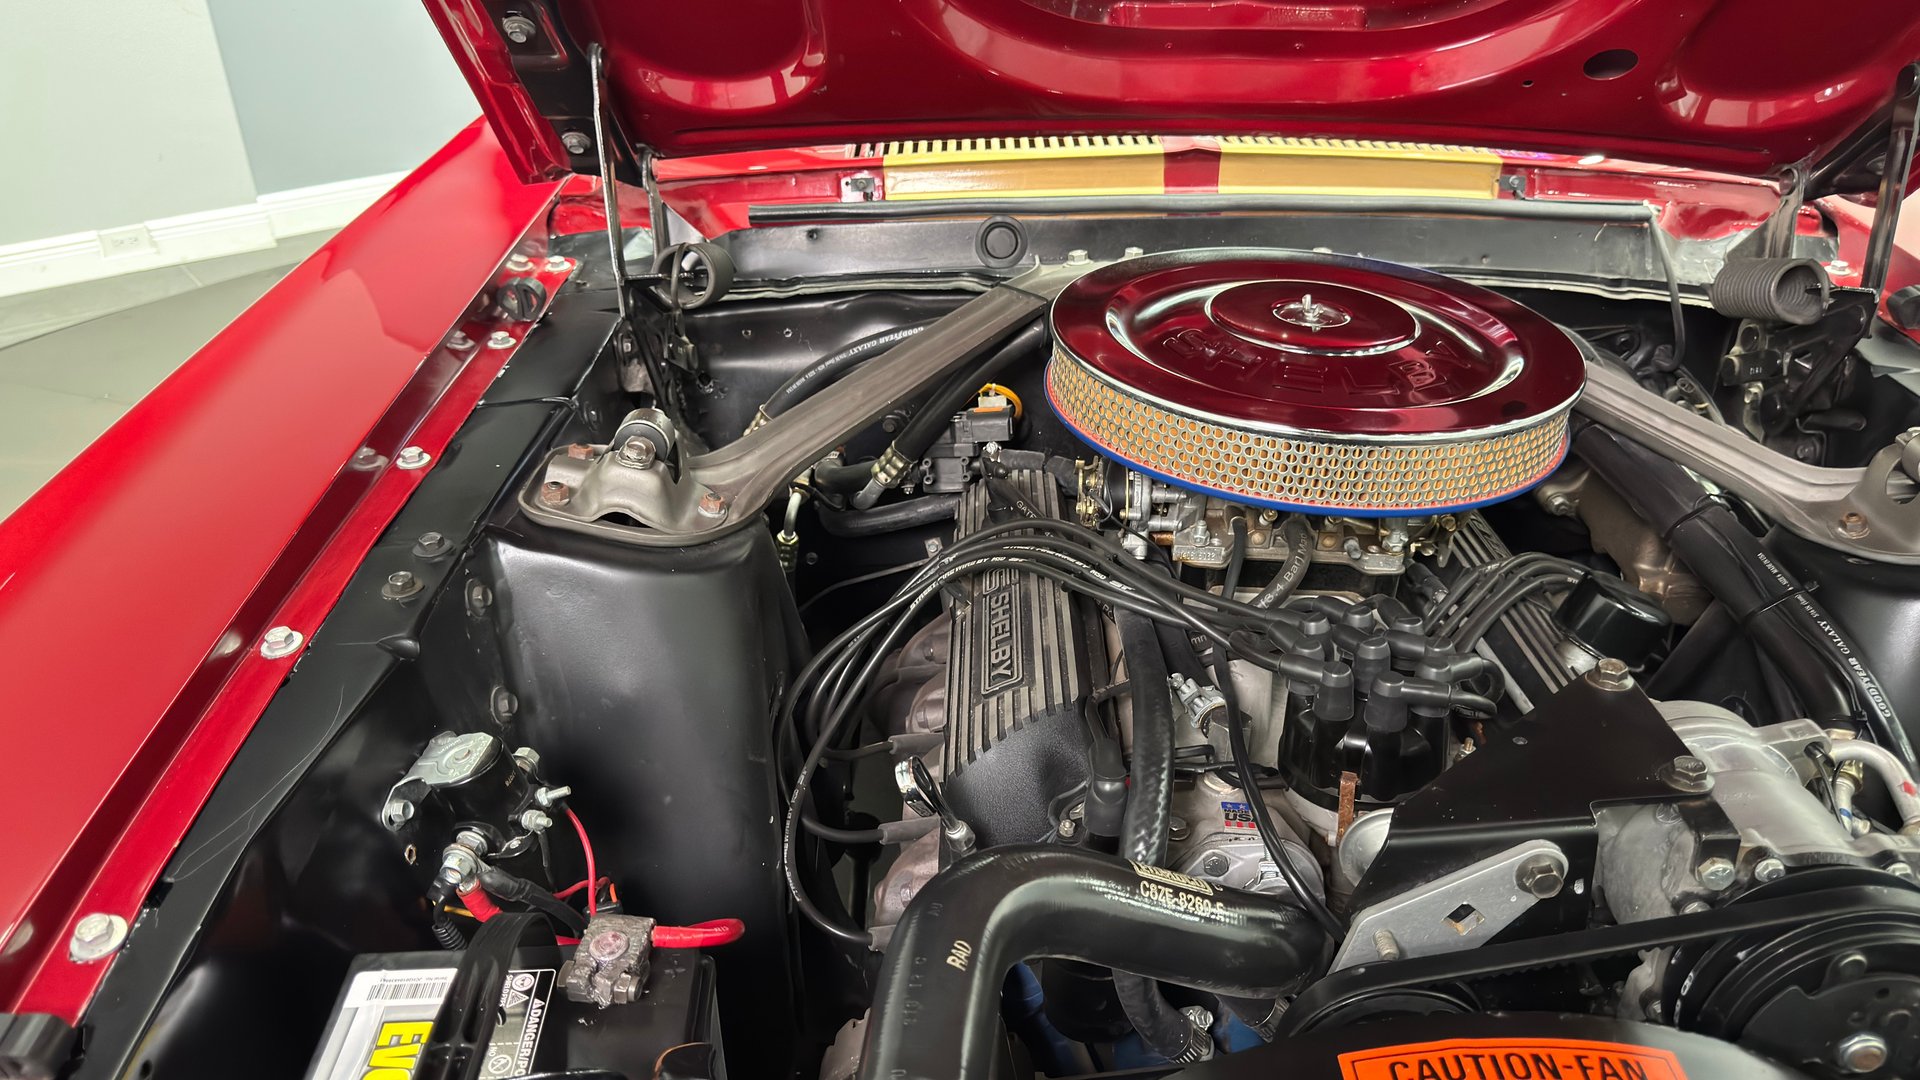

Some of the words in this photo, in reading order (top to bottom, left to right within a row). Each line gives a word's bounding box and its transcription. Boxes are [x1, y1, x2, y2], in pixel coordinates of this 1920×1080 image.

[848, 340, 877, 357] GALAXY
[879, 326, 924, 344] GOODYEAR
[1161, 328, 1472, 397] SHELBY
[990, 592, 1012, 679] SHELBY
[1817, 620, 1851, 655] GALAXY
[1848, 657, 1892, 718] GOODYEAR
[946, 939, 973, 972] RAD
[1389, 1053, 1649, 1080] CAUTION-FAN
